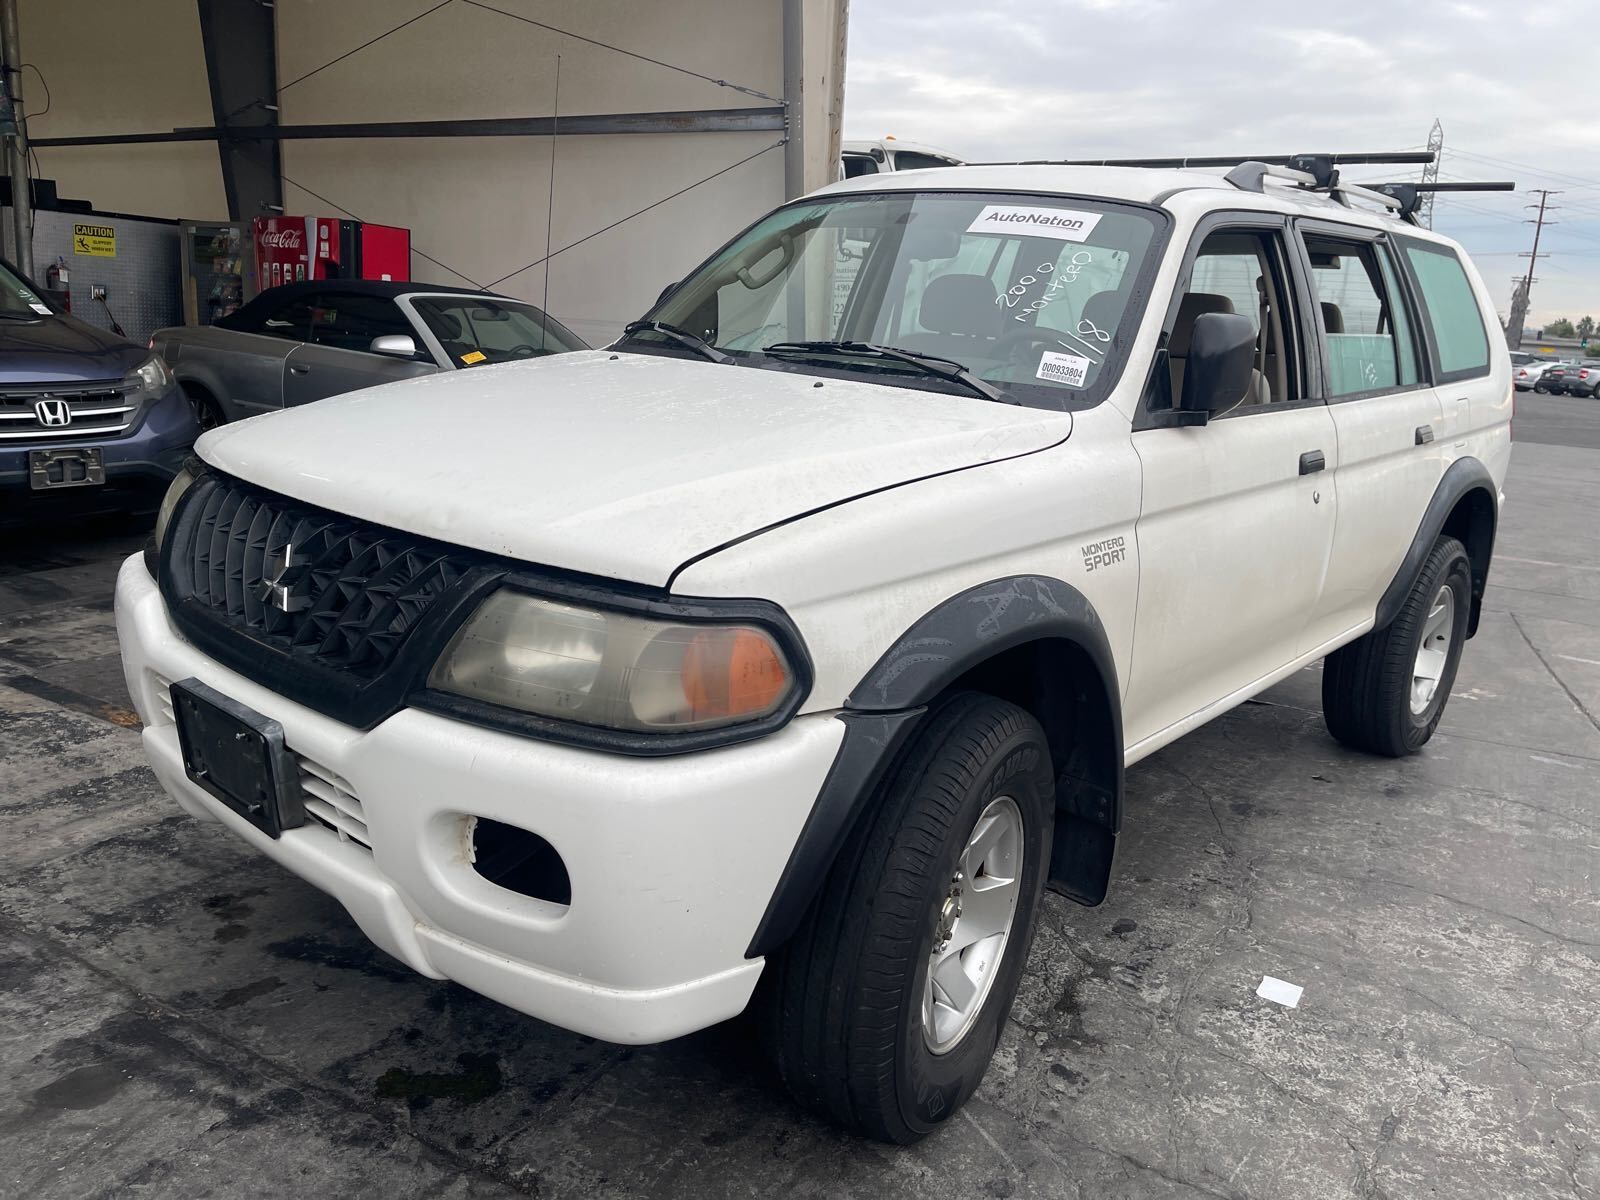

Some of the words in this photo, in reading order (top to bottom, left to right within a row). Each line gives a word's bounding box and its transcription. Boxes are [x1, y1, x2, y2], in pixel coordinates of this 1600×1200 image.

[985, 212, 1084, 230] AutoNation
[75, 225, 113, 237] CAUTION
[261, 229, 303, 248] Coca-Cola
[1042, 362, 1083, 378] 000933804
[1081, 536, 1125, 557] MONTERO
[1084, 547, 1126, 572] SPORT
